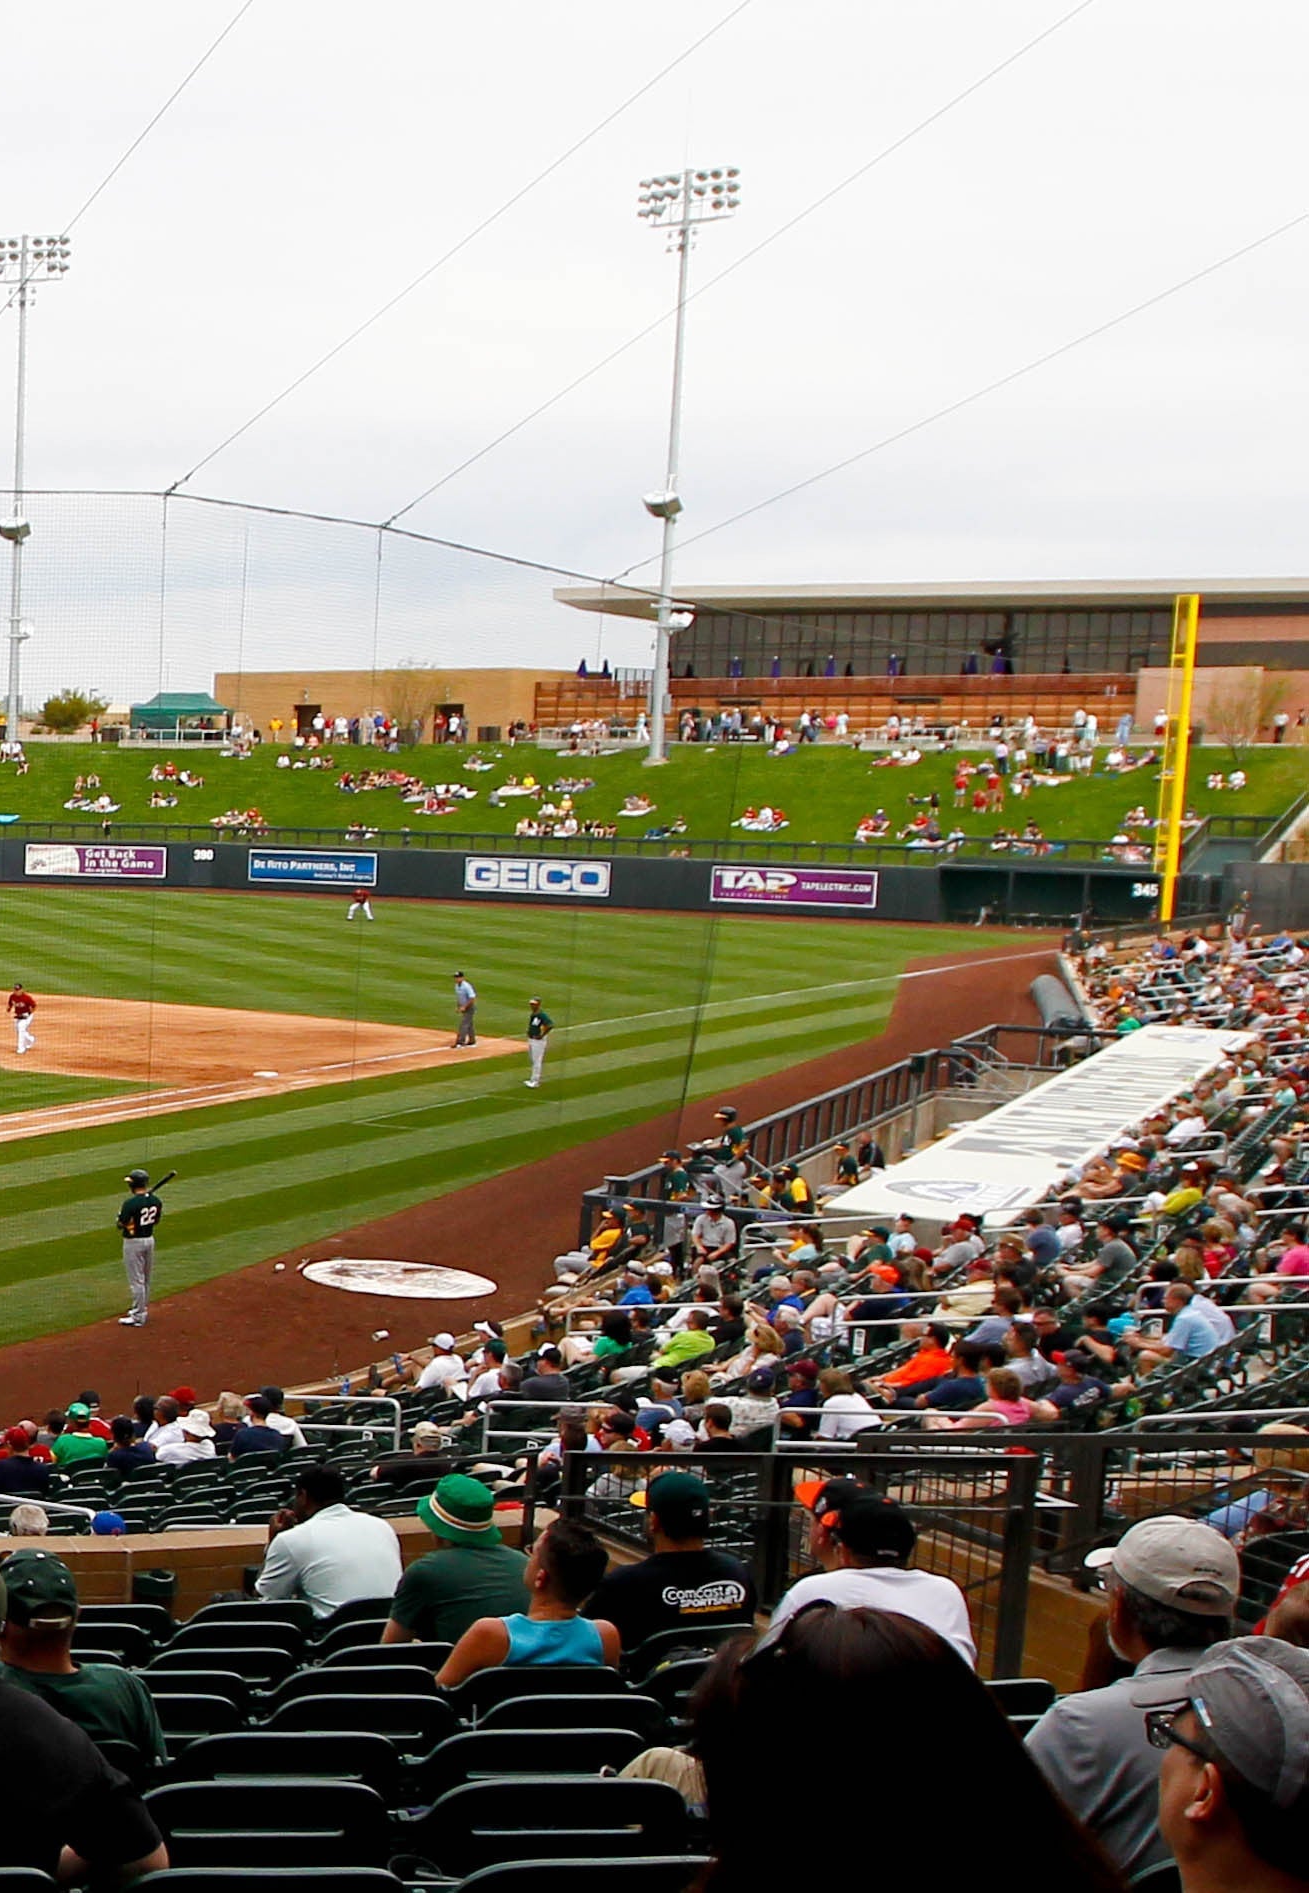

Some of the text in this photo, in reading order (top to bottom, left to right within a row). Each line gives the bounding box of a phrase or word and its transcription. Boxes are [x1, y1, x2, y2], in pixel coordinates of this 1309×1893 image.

[85, 849, 136, 860] Get Back
[99, 859, 118, 868] the
[121, 858, 154, 869] Game
[467, 860, 611, 894] GEICO
[715, 870, 798, 893] TAP
[1131, 882, 1159, 898] 345
[140, 1205, 158, 1227] 22
